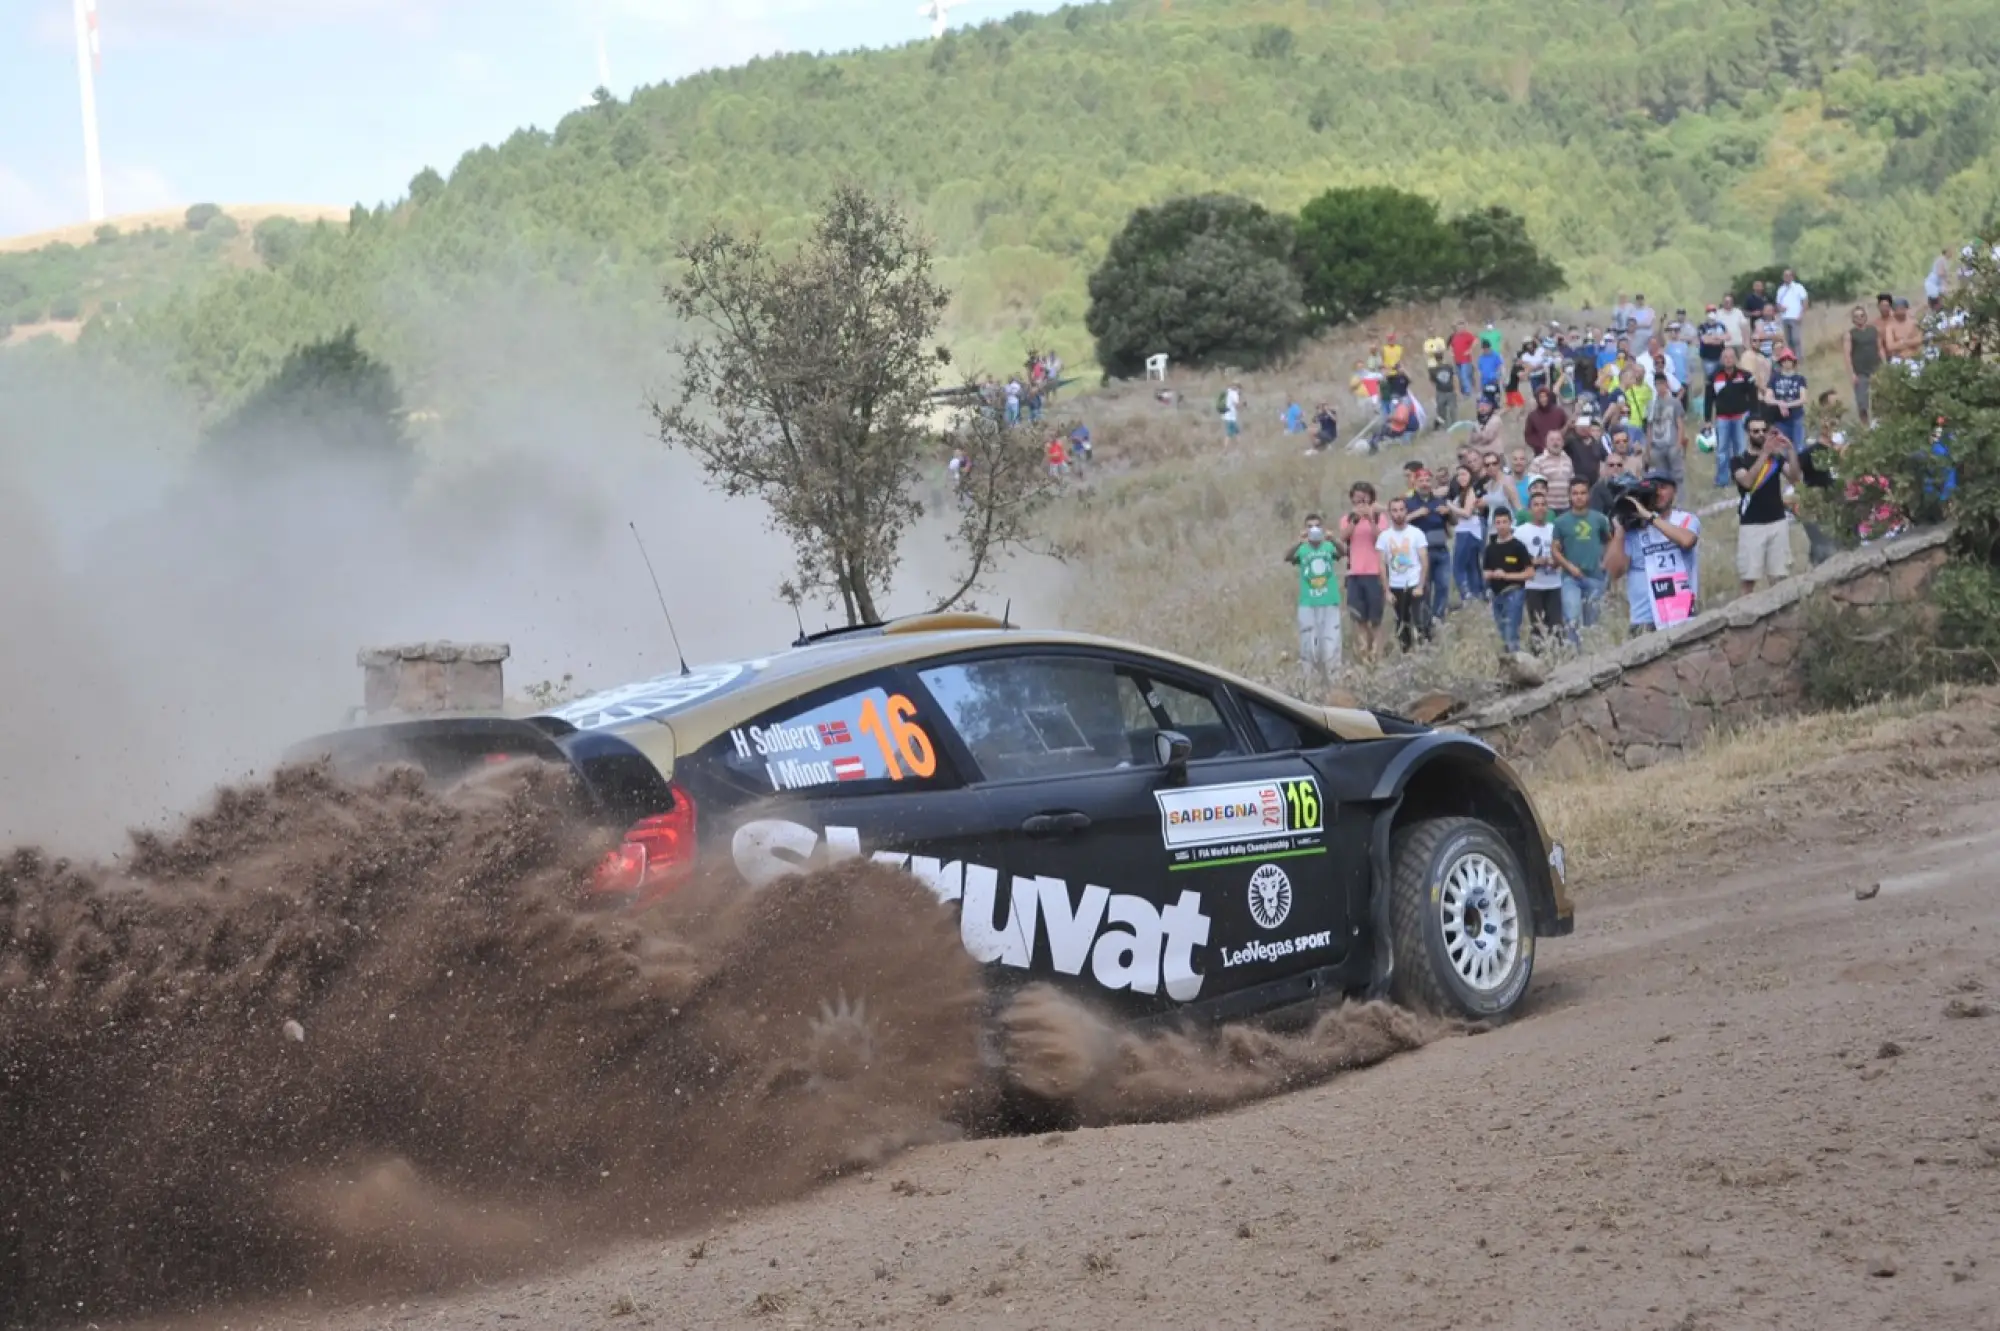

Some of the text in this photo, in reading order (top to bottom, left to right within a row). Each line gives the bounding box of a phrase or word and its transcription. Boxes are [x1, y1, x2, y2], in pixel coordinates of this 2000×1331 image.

[1657, 553, 1676, 568] 21
[730, 722, 822, 758] H Solberg
[858, 694, 937, 781] 16
[765, 758, 833, 792] I Minor
[1169, 802, 1257, 825] SARDEGNA
[1259, 789, 1281, 827] 2016
[1287, 780, 1318, 829] 16
[1211, 846, 1229, 857] World
[1230, 844, 1246, 855] Rally
[1246, 839, 1290, 852] Championship
[1220, 930, 1331, 968] LeoVegas SPORT
